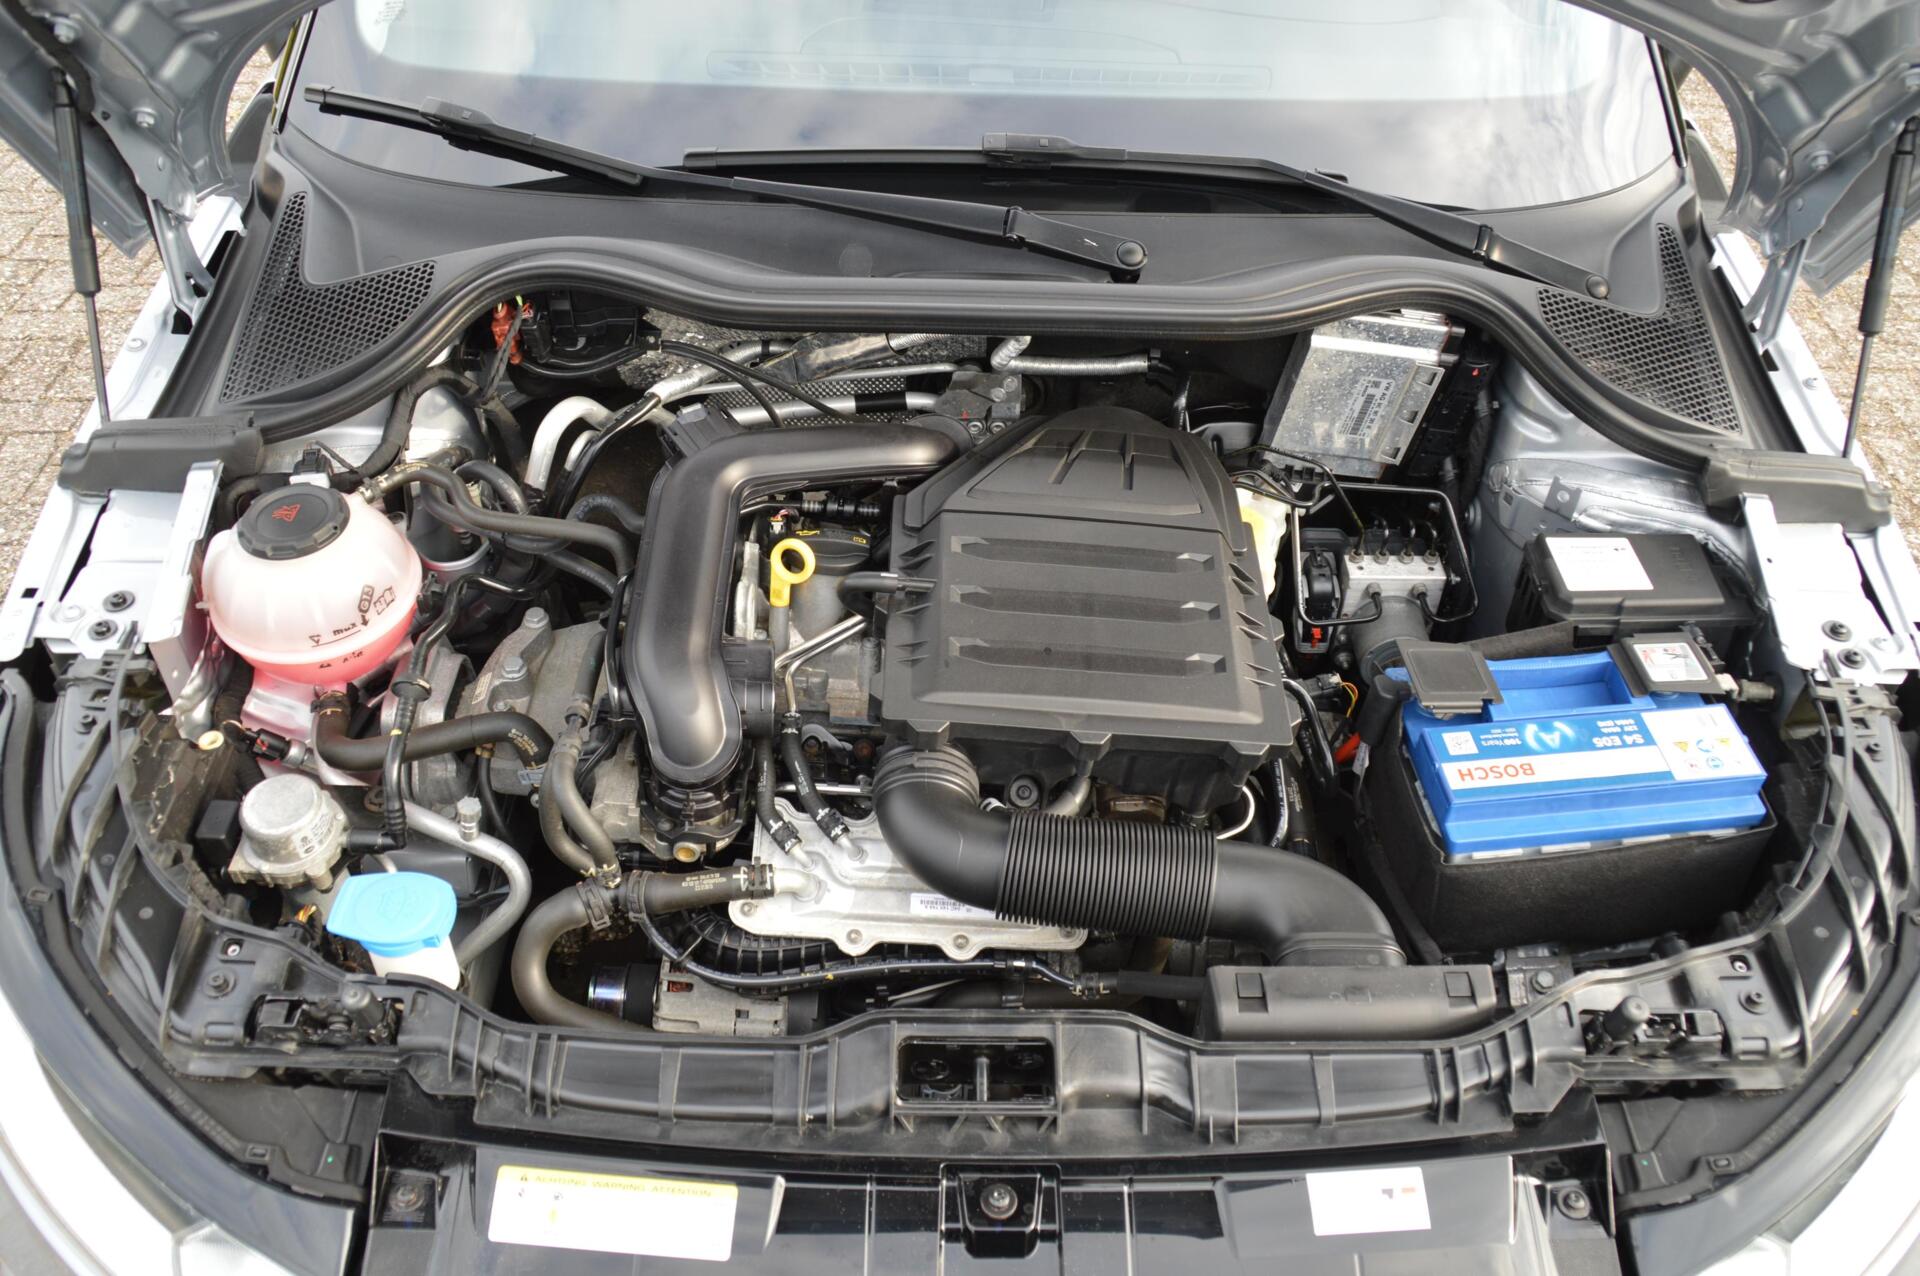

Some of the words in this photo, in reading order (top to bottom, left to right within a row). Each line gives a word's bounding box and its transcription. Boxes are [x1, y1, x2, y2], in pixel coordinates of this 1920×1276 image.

[1384, 381, 1393, 391] VW
[1592, 735, 1623, 748] E05
[1623, 733, 1645, 745] S4
[1457, 762, 1536, 782] BOSCH
